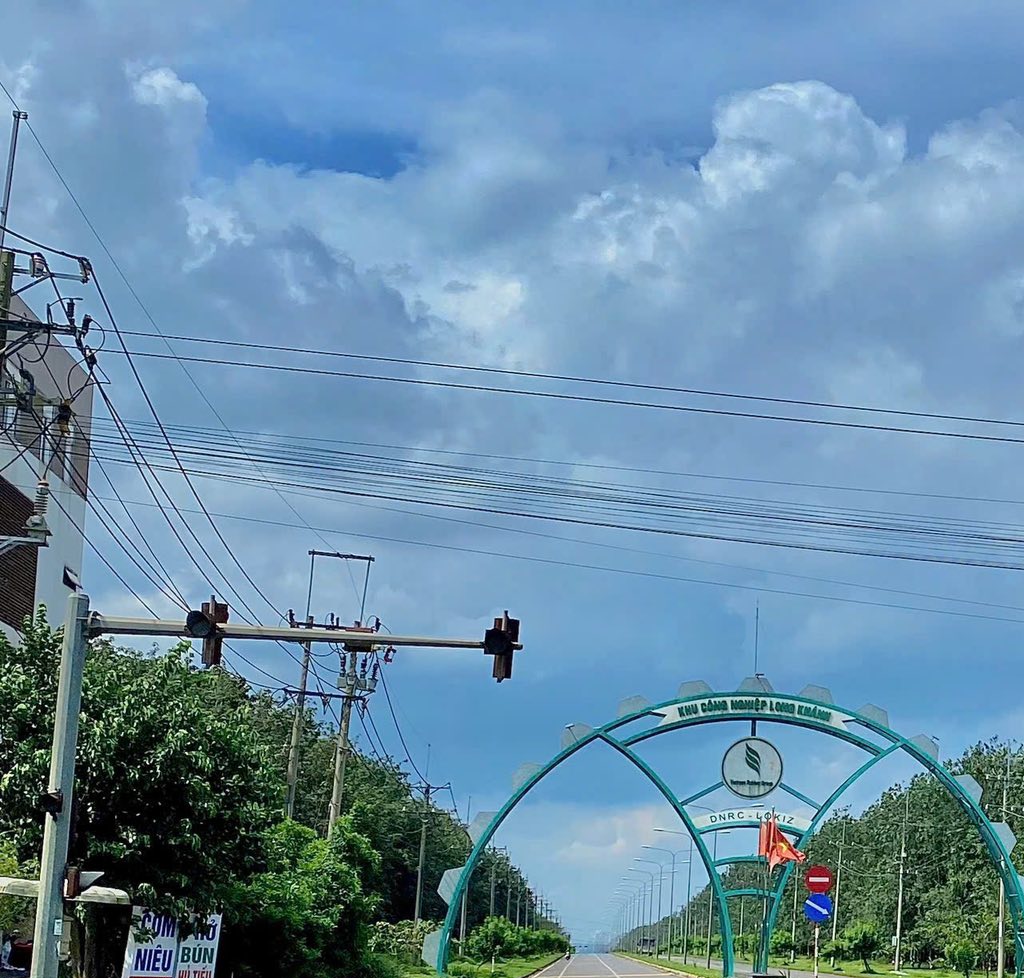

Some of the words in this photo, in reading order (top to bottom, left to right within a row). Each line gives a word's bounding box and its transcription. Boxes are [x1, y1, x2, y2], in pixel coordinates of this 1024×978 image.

[677, 703, 699, 718] KHU
[700, 699, 728, 713] CÔNG
[730, 697, 768, 713] NGHIỆP
[769, 700, 796, 715] LONG
[797, 704, 832, 722] KHÁNH
[709, 811, 745, 823] DNRC
[756, 811, 795, 825] LOKIZ
[134, 945, 174, 972] NIÊU
[180, 943, 215, 964] BÚN
